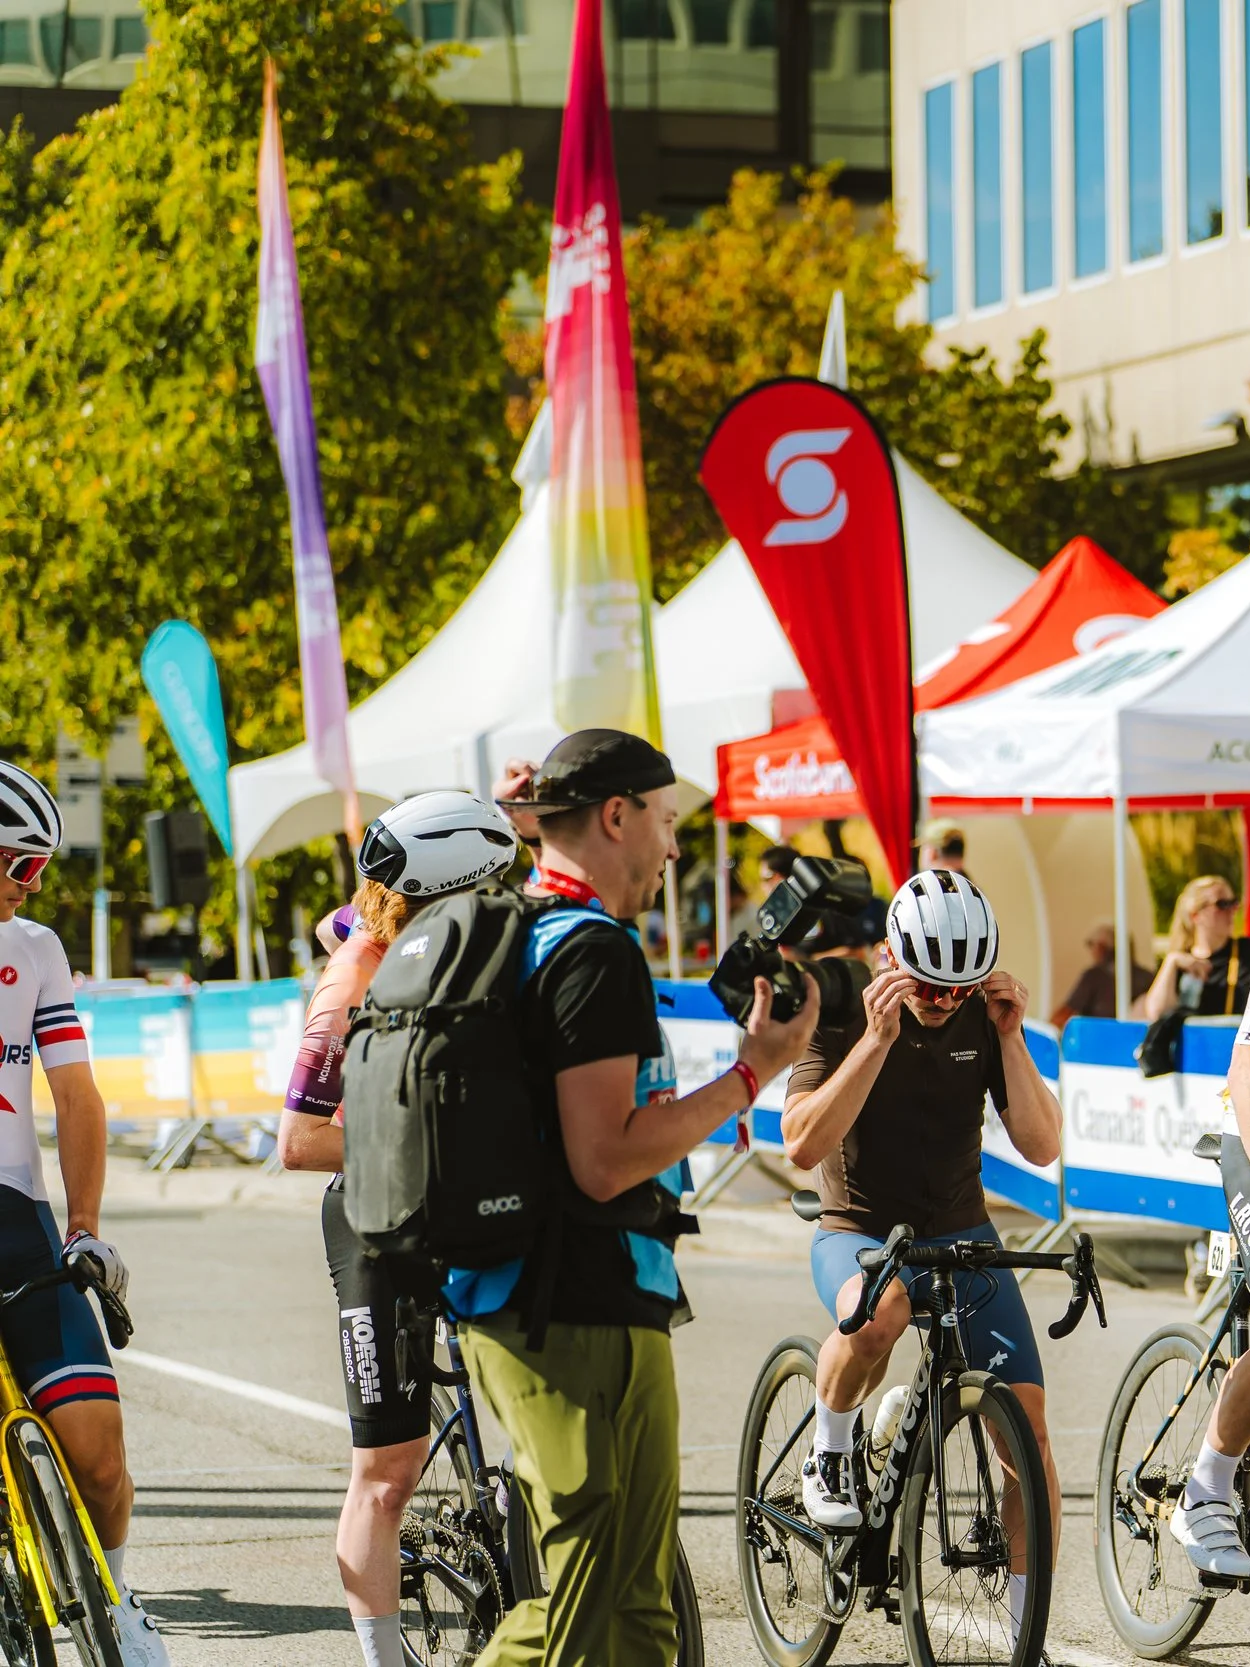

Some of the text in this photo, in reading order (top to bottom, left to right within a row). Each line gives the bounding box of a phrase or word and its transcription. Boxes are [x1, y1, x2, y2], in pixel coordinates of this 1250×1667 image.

[422, 856, 497, 895] S-WORKS
[317, 1035, 340, 1085] EXCAVATION
[1072, 1088, 1147, 1147] Canada
[477, 1195, 522, 1216] evoc
[342, 1329, 355, 1384] OBERSON
